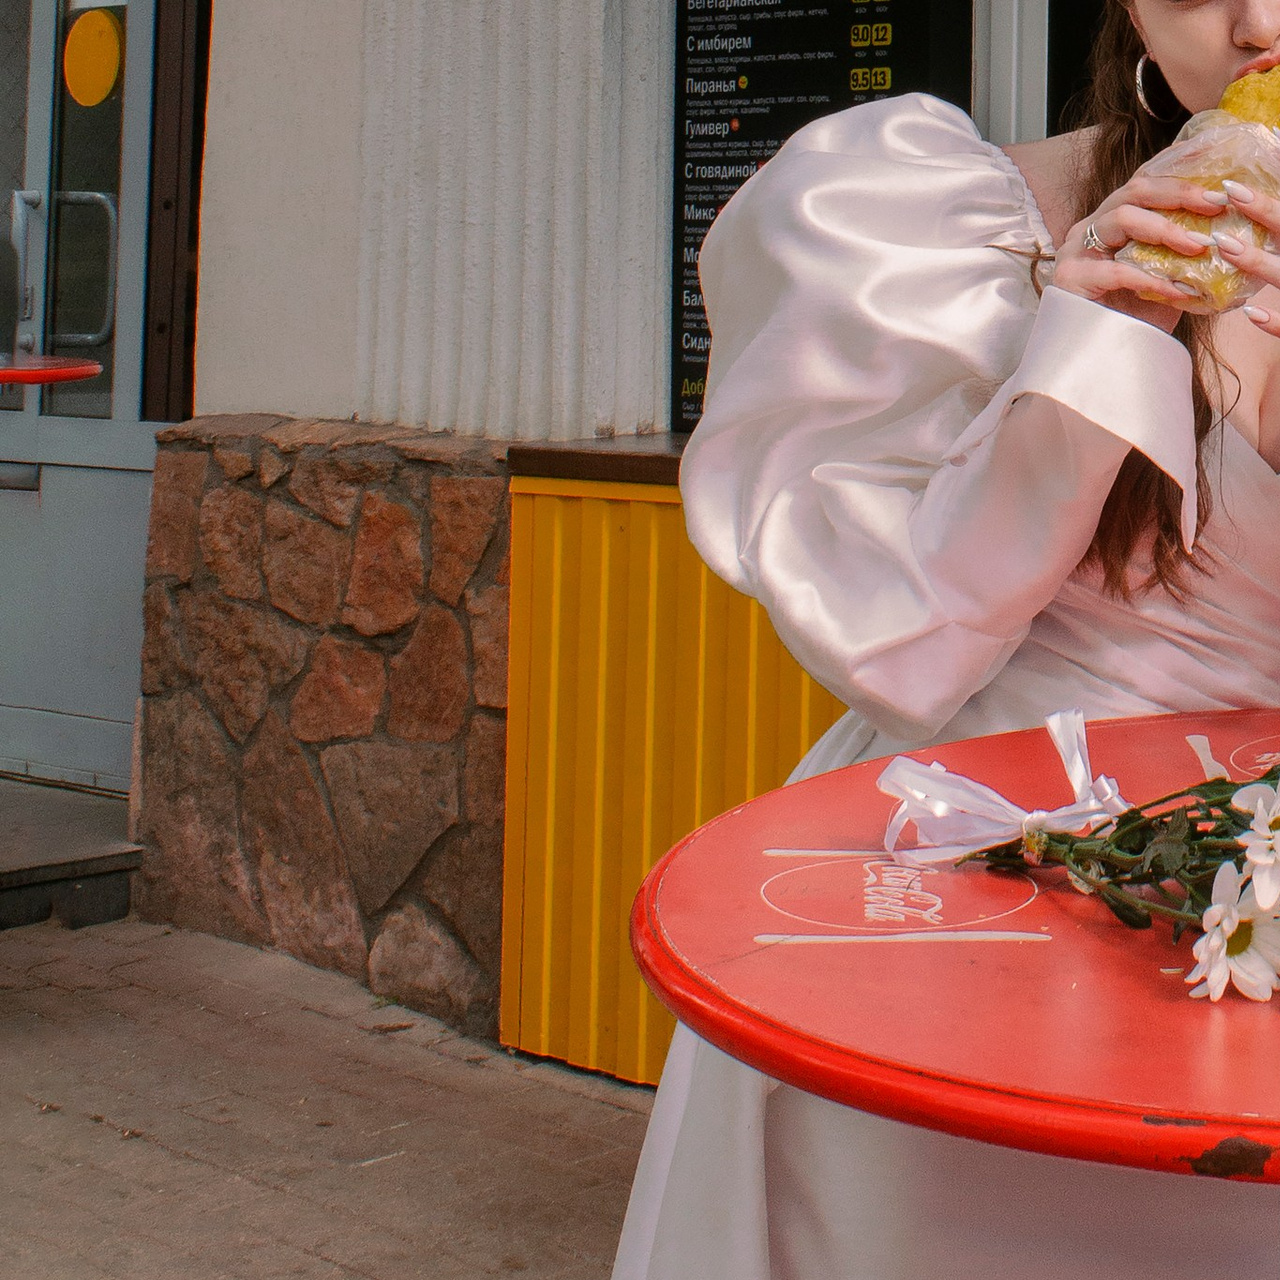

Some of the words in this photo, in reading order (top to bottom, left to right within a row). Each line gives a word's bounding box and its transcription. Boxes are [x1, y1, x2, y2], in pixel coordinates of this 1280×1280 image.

[686, 36, 694, 51] С
[697, 32, 751, 53] имбирем
[852, 26, 868, 40] 9.0
[874, 27, 886, 41] 12
[685, 77, 735, 96] Пиранья
[852, 71, 868, 87] 9.5
[872, 71, 885, 85] 13
[685, 120, 729, 138] Гуливер
[684, 162, 692, 178] С
[695, 161, 756, 179] говядиной
[684, 204, 715, 220] Микс
[682, 333, 710, 351] Сидн
